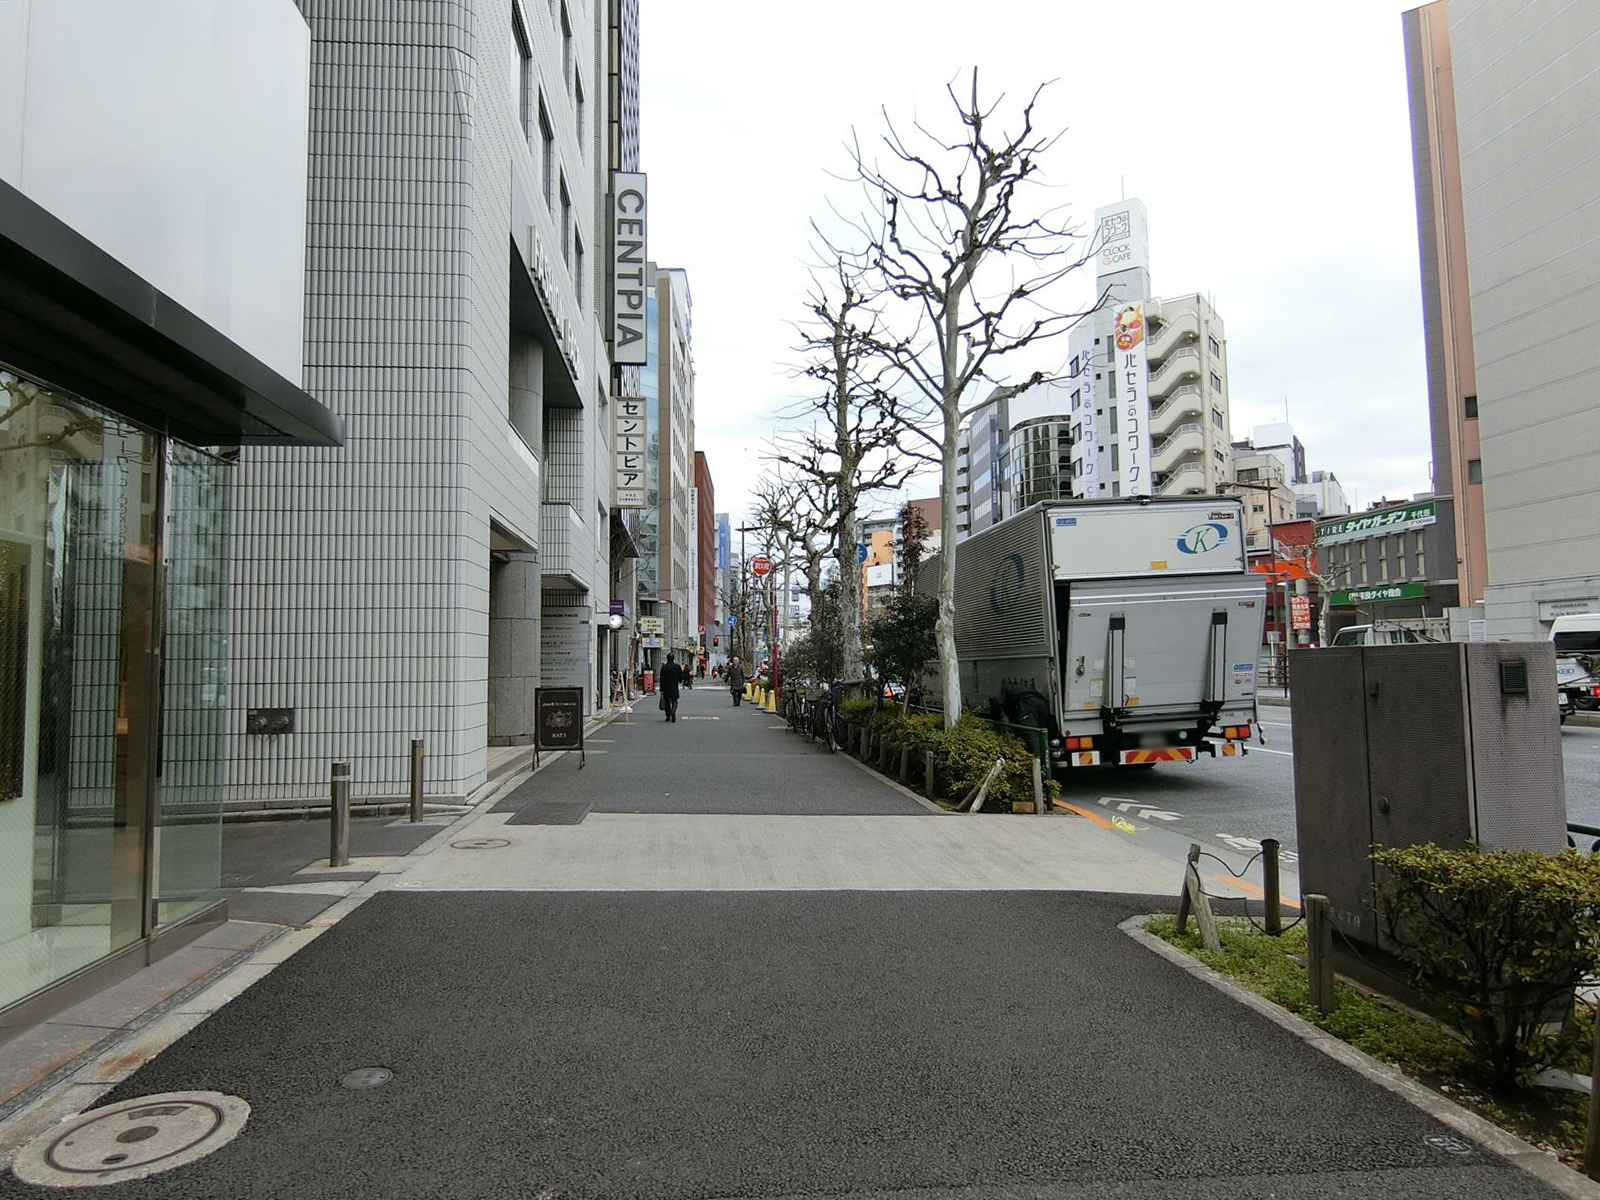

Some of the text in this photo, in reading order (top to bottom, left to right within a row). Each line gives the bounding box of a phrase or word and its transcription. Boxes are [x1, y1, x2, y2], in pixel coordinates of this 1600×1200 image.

[1102, 243, 1131, 258] CLOCK
[616, 187, 645, 348] CENTPIA
[622, 400, 640, 486] セントピア
[1345, 510, 1407, 533] タイヤガーデン
[1410, 509, 1431, 519] 千代田
[1191, 528, 1212, 554] K
